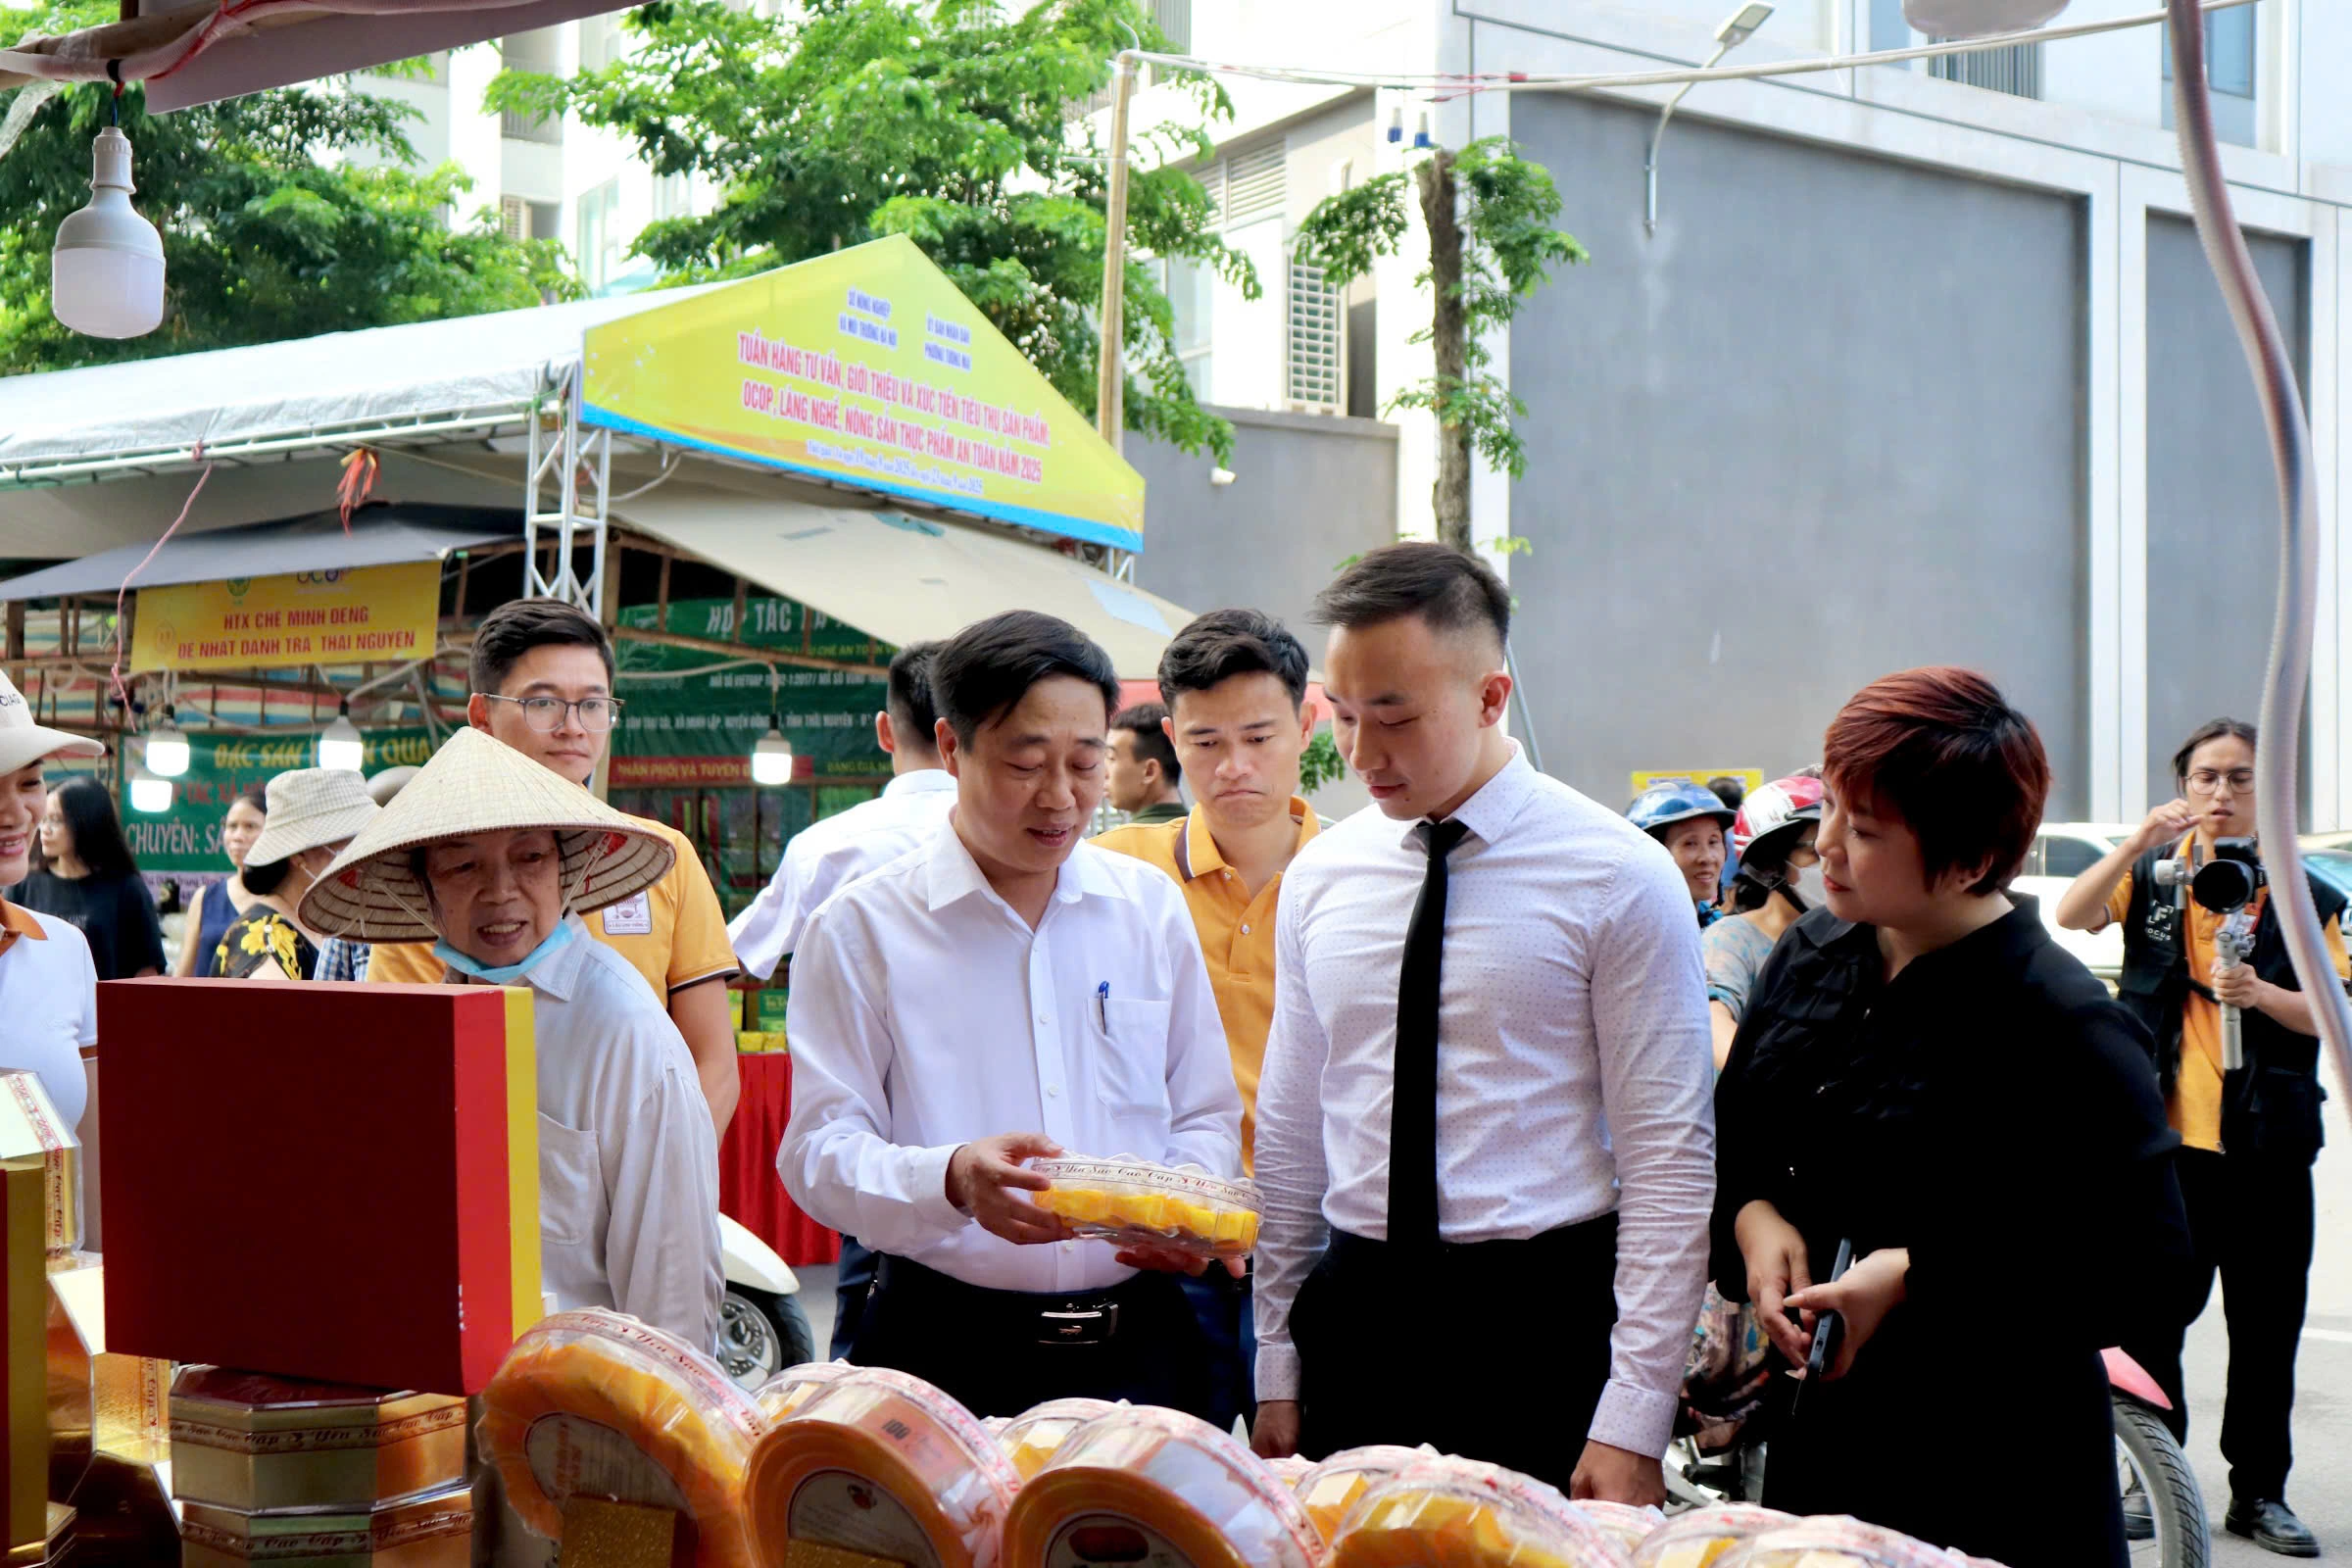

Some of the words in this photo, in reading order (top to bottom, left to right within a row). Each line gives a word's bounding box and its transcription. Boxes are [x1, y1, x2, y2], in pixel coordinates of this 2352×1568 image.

[771, 337, 802, 374] HÀNG
[956, 439, 970, 464] AN
[1021, 457, 1042, 484] 2025
